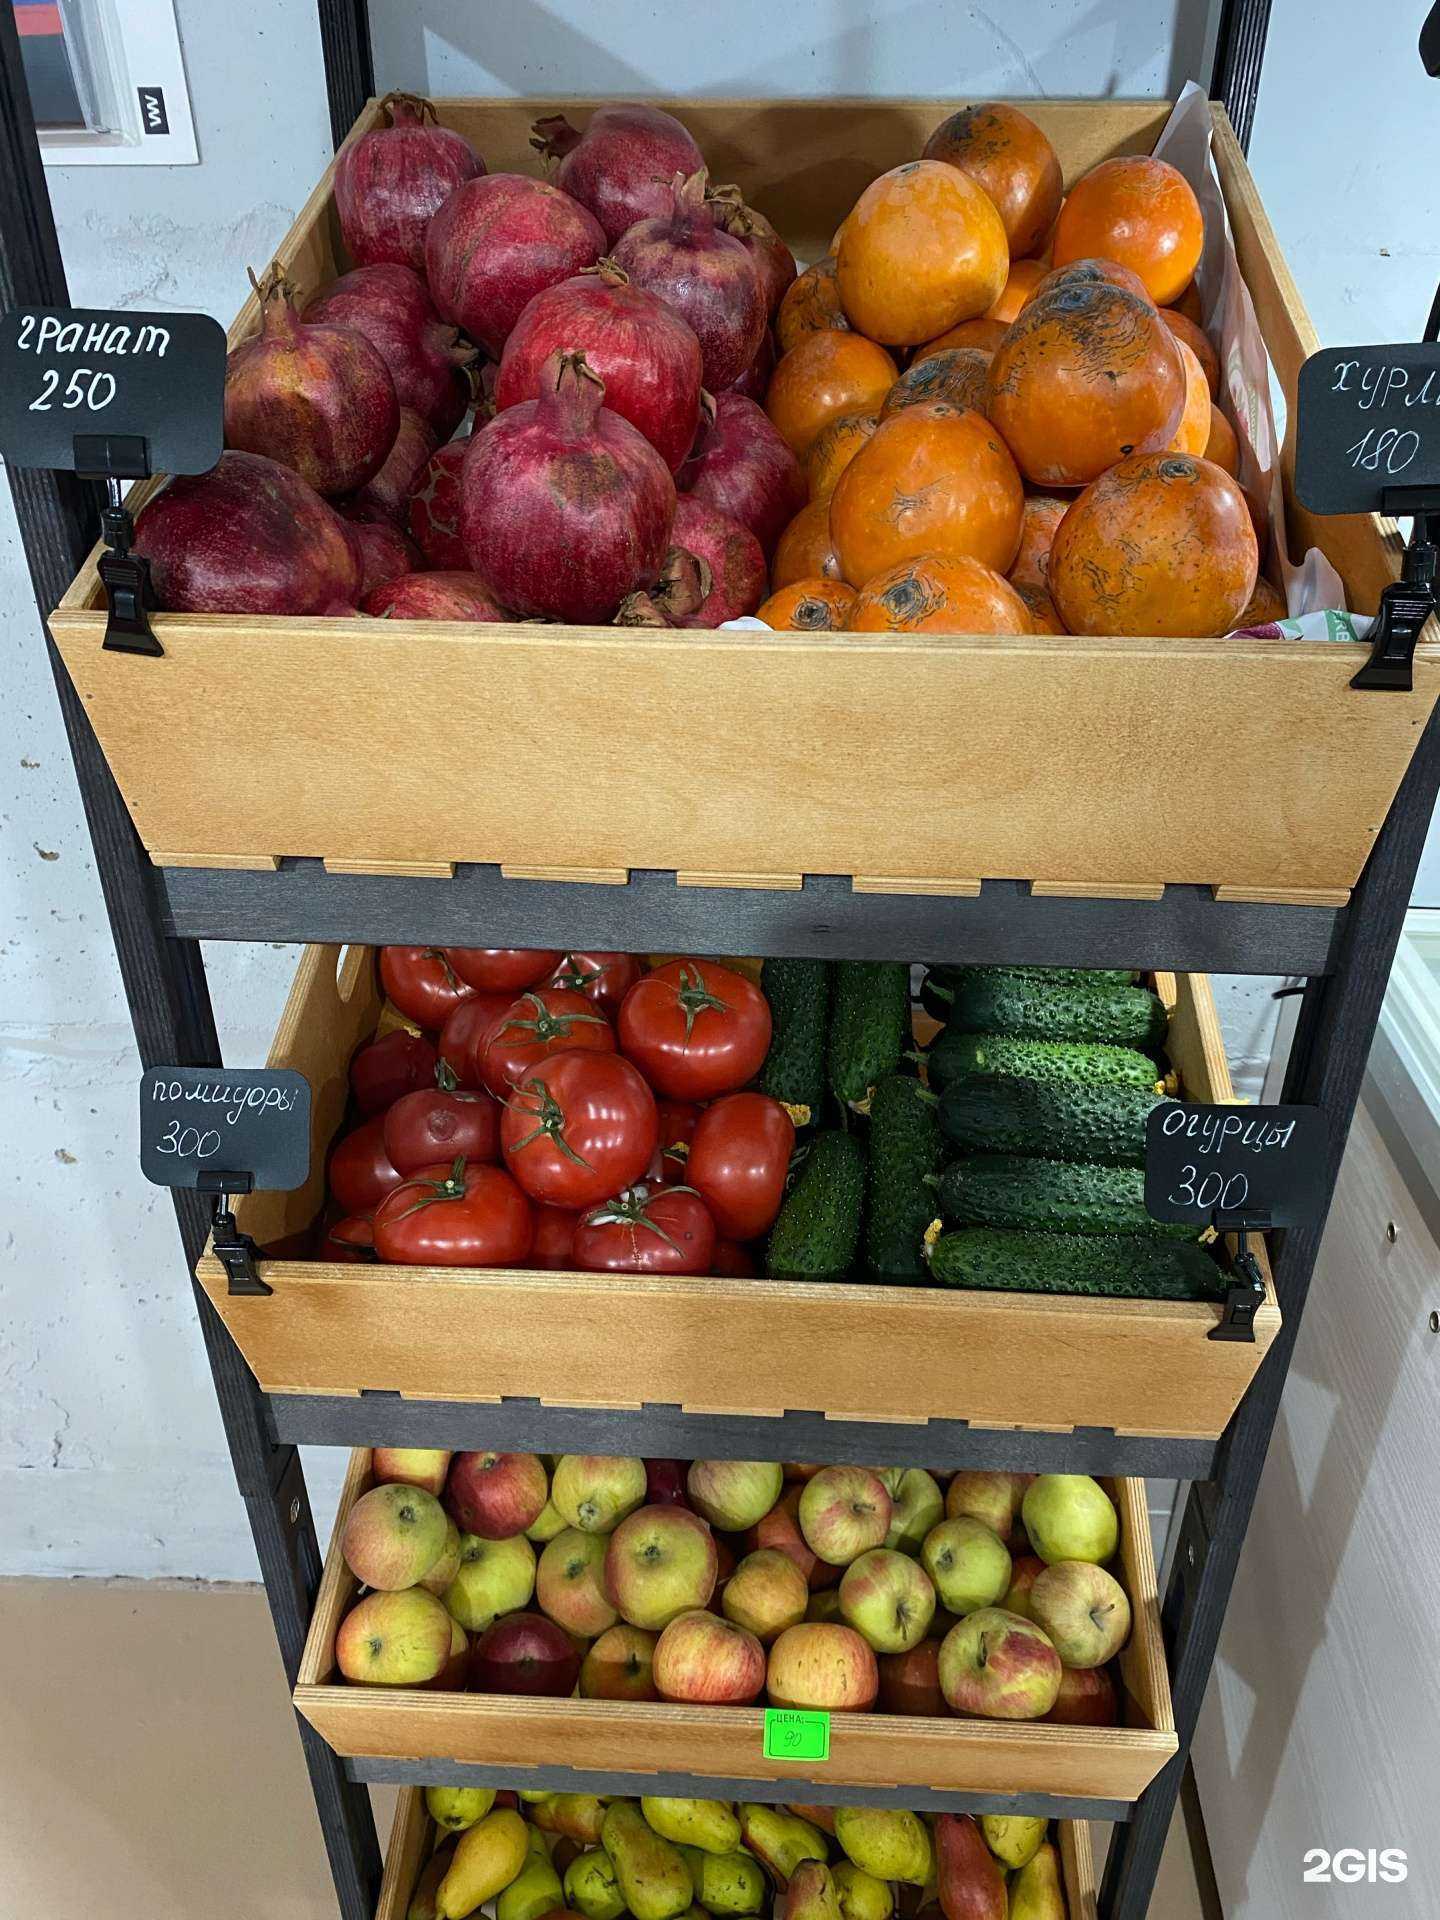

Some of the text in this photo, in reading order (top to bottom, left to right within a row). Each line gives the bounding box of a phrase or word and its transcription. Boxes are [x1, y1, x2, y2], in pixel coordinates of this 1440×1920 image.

[28, 368, 117, 411] 250
[1345, 428, 1420, 474] 180
[152, 1080, 299, 1125] помидоры
[156, 1120, 222, 1158] 300
[1168, 1165, 1249, 1209] 300
[783, 1730, 802, 1748] 90
